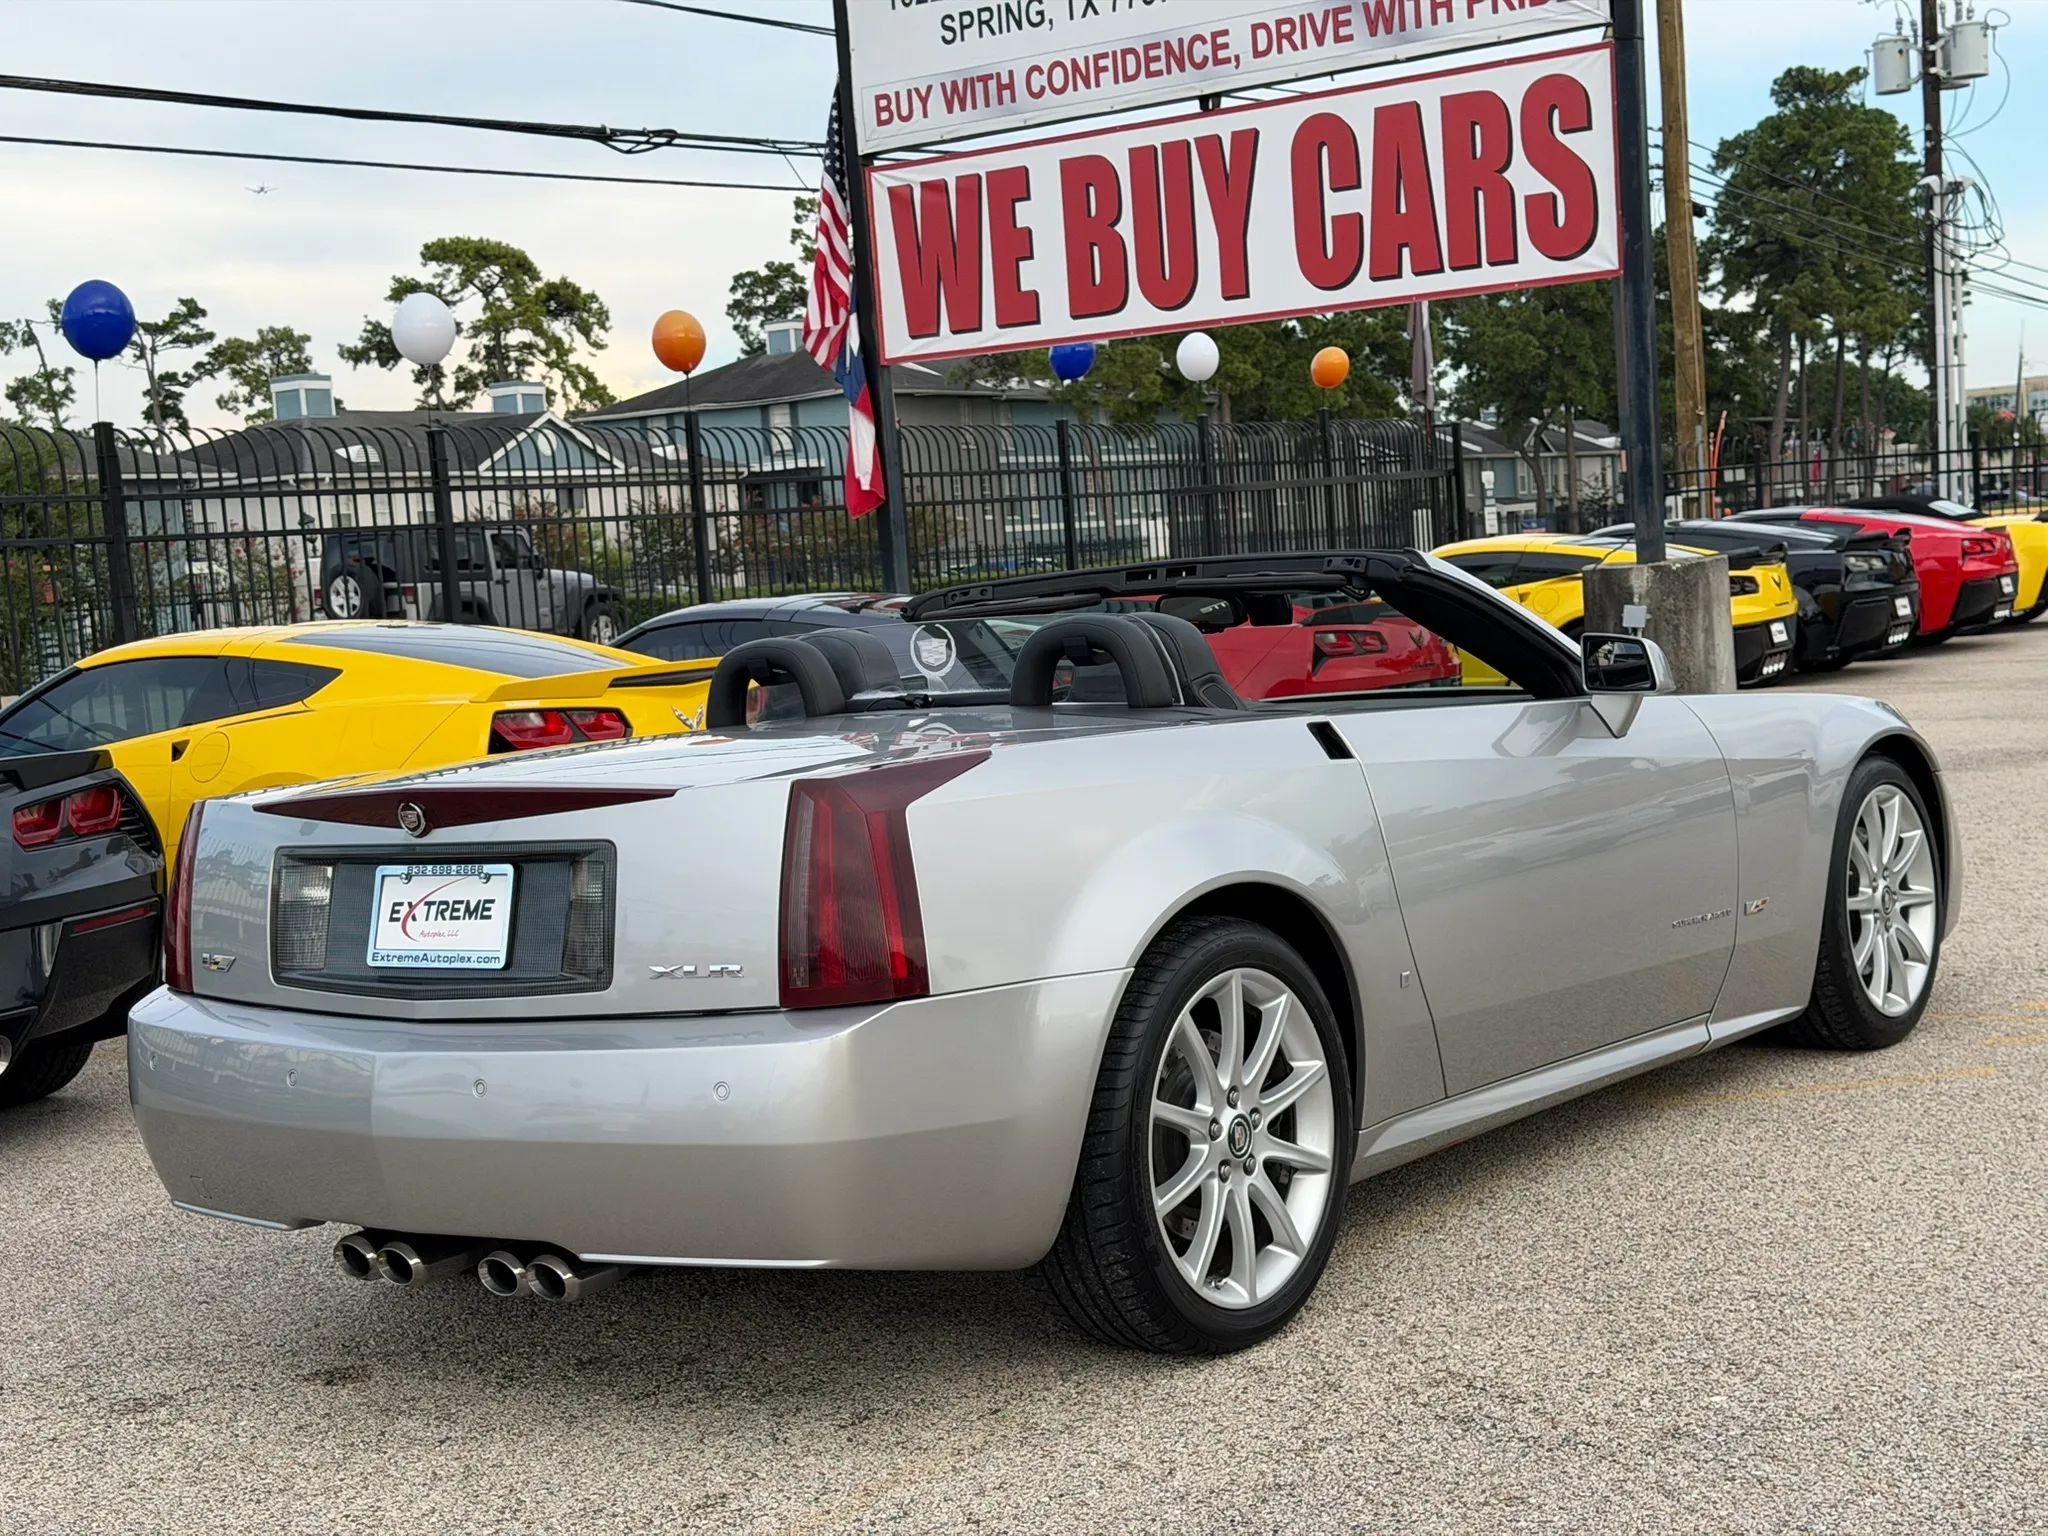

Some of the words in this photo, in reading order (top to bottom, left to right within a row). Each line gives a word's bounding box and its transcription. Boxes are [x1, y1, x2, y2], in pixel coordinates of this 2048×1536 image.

[940, 0, 1054, 46] SPRING,
[874, 84, 934, 127] BUY
[940, 69, 1017, 114] WITH
[1025, 29, 1241, 101] CONFIDENCE,
[1250, 5, 1355, 60] DRIVE
[1362, 0, 1454, 38] WITH
[887, 164, 1041, 340] WE
[1059, 127, 1261, 320] BUY
[1290, 73, 1599, 291] CARS
[388, 898, 496, 923] EXTREME
[371, 952, 501, 966] ExtremeAutoplex.com
[648, 964, 744, 980] XLR
